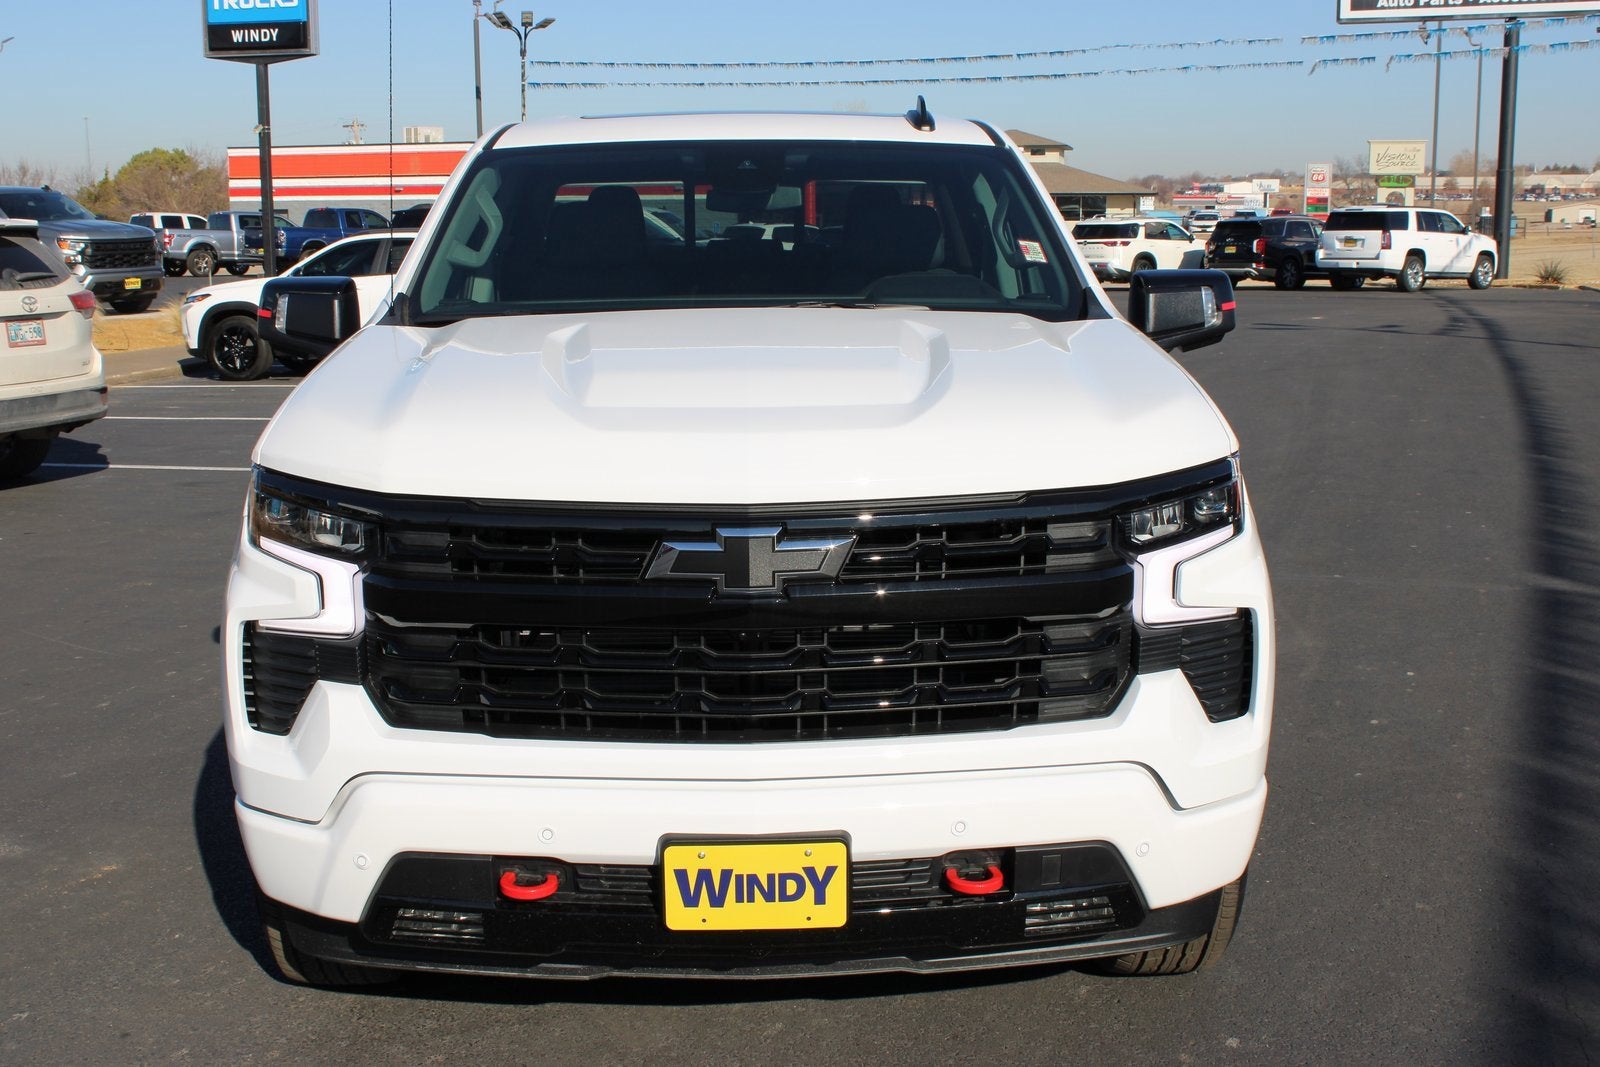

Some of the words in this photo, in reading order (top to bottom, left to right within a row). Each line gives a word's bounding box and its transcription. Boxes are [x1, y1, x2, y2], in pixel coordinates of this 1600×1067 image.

[231, 28, 279, 43] WINDY
[1312, 173, 1324, 181] 66
[673, 865, 839, 908] WINDY
